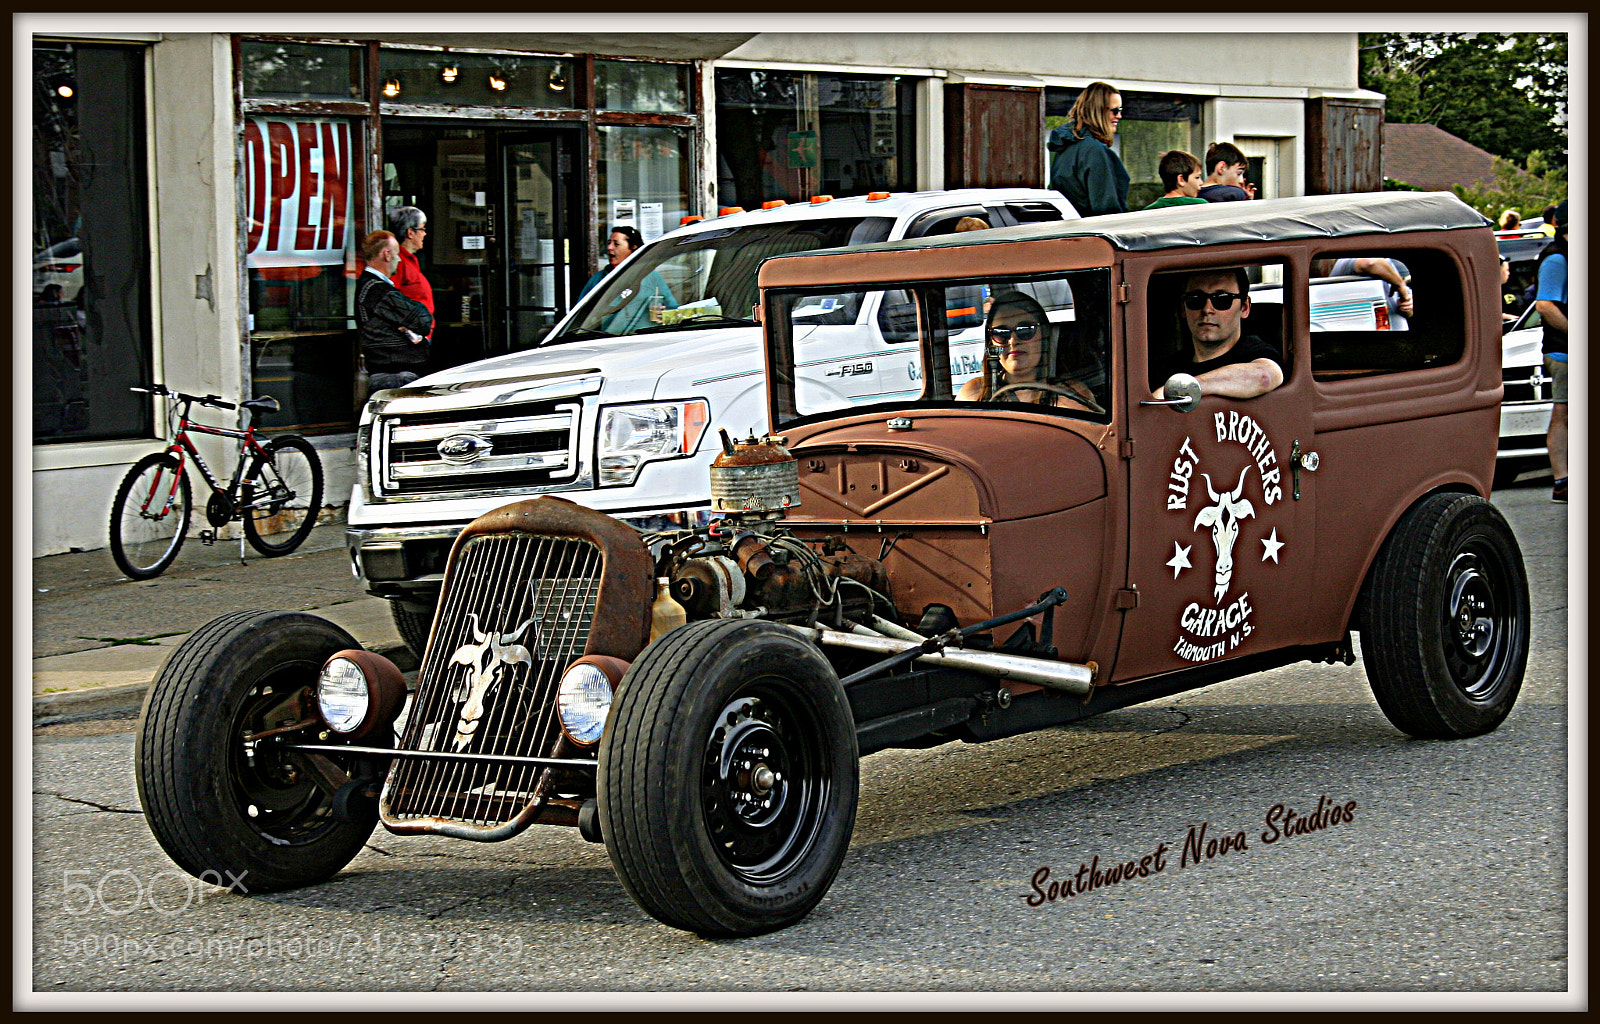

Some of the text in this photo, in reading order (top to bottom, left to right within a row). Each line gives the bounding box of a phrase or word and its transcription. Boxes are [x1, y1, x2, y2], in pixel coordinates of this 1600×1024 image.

[244, 118, 349, 254] OPEN
[1167, 410, 1283, 510] RUST BROTHERS
[1172, 624, 1256, 662] YARMOUTH N.S.
[1180, 592, 1253, 637] GARAGE
